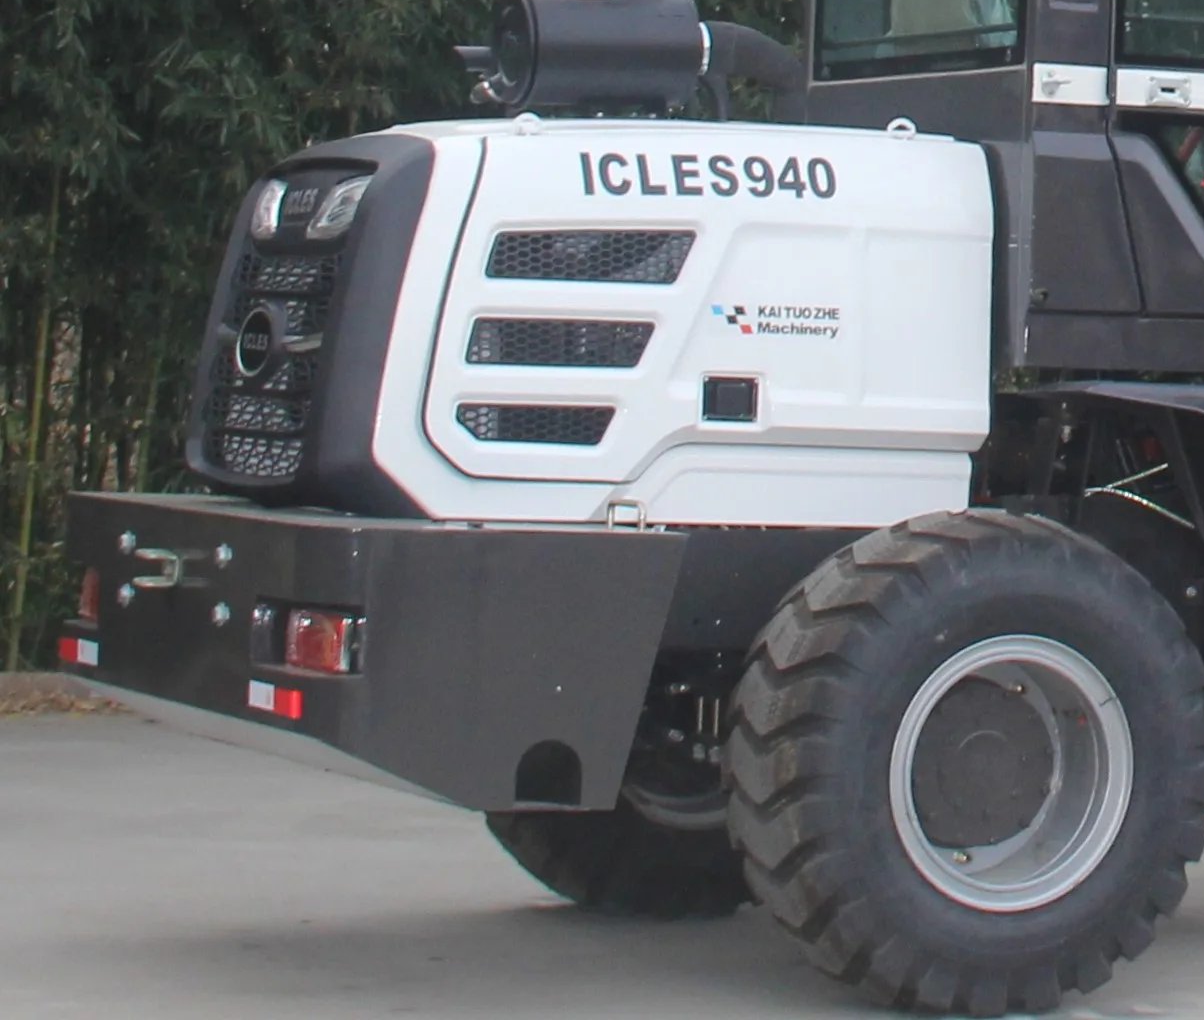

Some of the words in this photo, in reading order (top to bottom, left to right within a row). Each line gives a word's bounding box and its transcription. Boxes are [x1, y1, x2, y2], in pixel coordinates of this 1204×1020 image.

[580, 152, 836, 199] ICLES940
[757, 305, 781, 318] KAI
[784, 306, 811, 319] TUO
[814, 307, 839, 320] ZHE
[757, 321, 839, 339] Machinery
